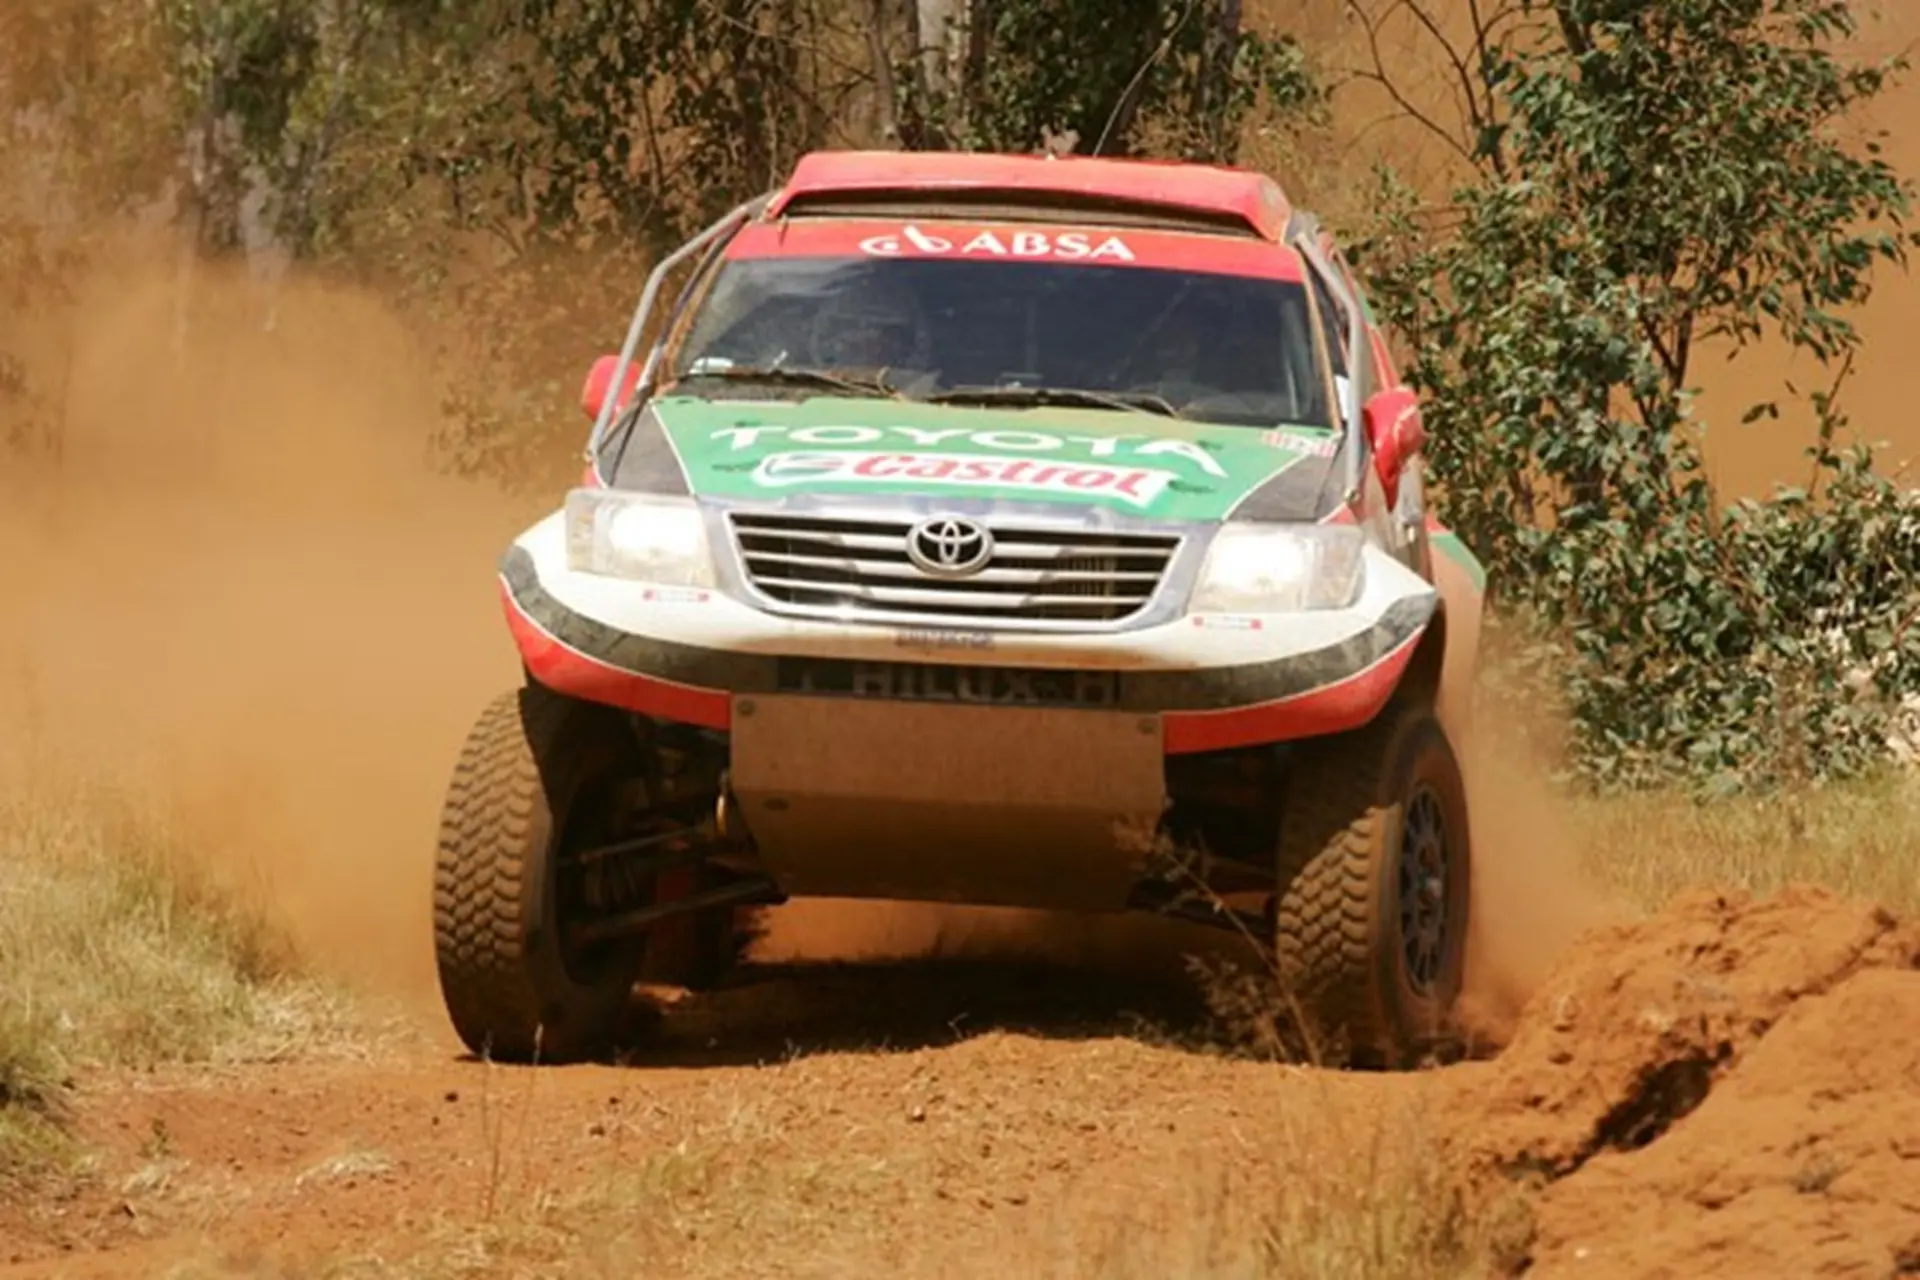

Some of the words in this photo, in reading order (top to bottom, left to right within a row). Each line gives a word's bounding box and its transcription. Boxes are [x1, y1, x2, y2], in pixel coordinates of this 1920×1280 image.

[961, 230, 1136, 262] ABSA
[710, 425, 1229, 478] TOYOTA
[852, 454, 1149, 498] Castrol
